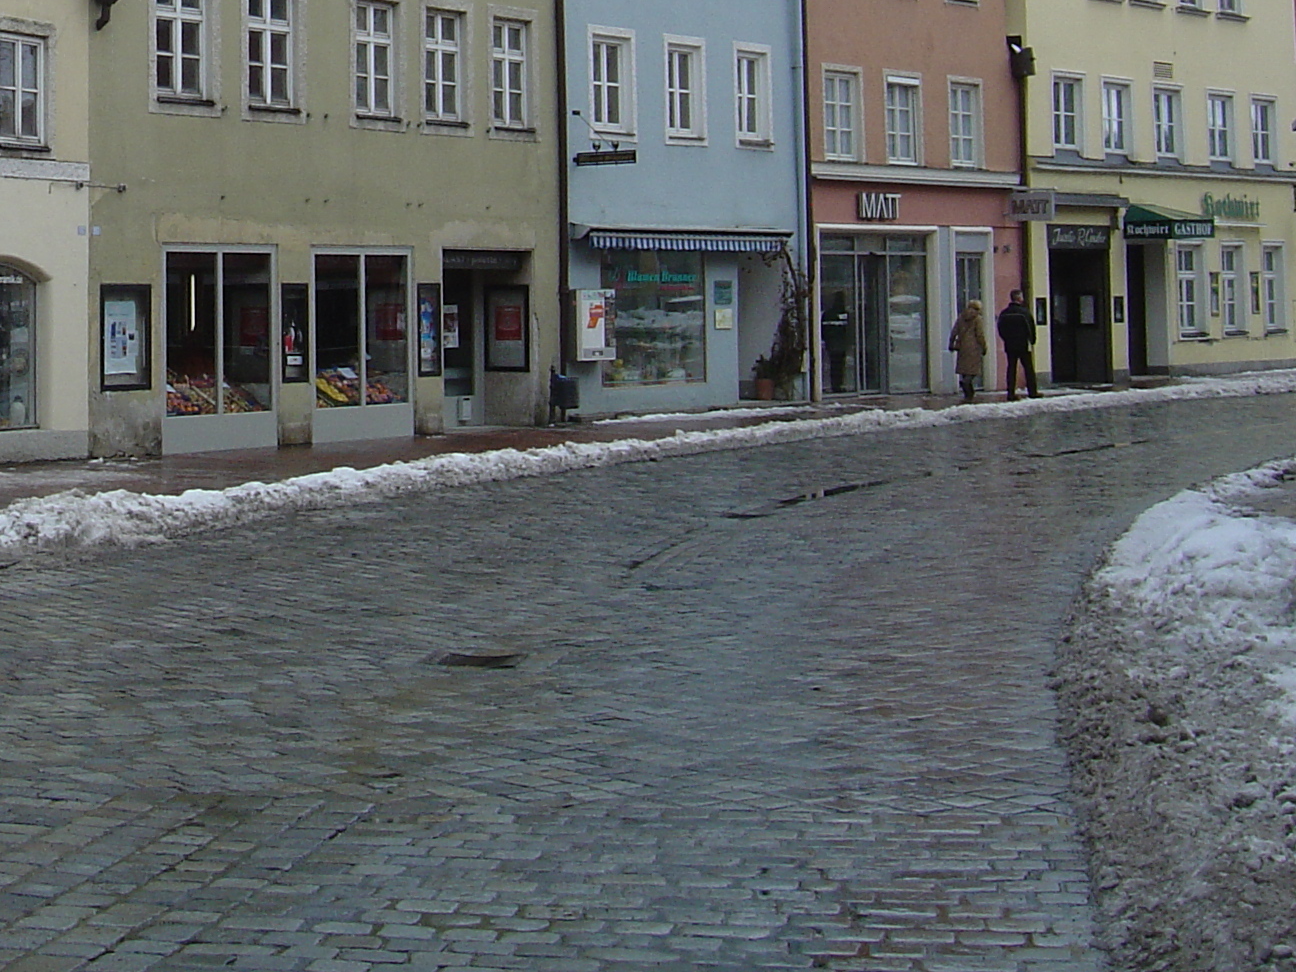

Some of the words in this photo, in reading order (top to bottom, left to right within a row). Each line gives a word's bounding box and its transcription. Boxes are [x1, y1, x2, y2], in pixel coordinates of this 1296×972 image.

[860, 192, 902, 220] MATT
[1012, 198, 1049, 215] MATT
[1126, 223, 1169, 237] Kochwirt
[1174, 222, 1213, 236] GASTHOF
